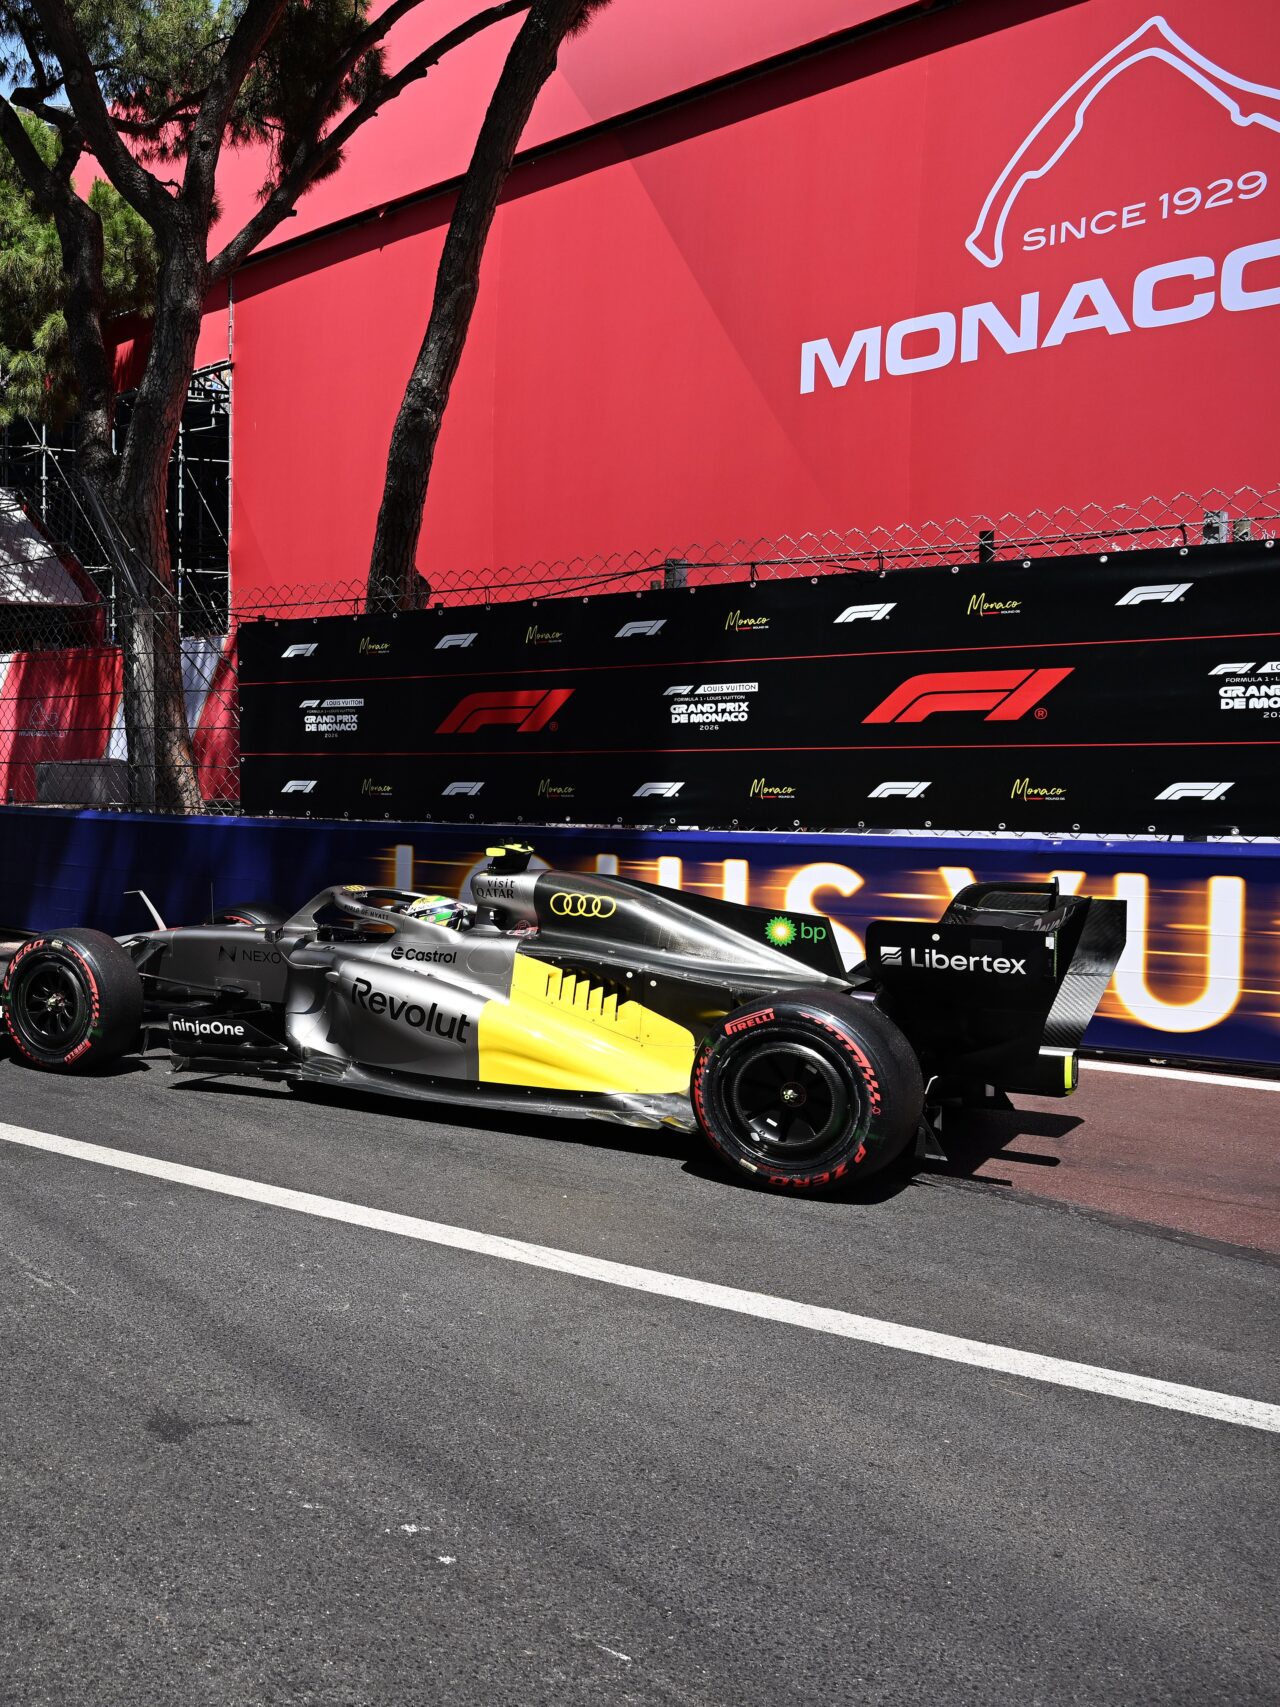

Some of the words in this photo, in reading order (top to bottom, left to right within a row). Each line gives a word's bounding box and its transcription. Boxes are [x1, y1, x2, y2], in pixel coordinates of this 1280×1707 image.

[1022, 202, 1146, 250] SINCE
[1157, 170, 1268, 220] 1929
[799, 238, 1280, 395] MONACO
[966, 592, 1022, 616] Monaco
[724, 610, 770, 631] Monaco
[525, 625, 563, 645] Monaco
[861, 667, 1075, 723] F1
[1220, 698, 1247, 710] DE
[434, 688, 575, 734] F1
[670, 703, 716, 713] GRAND
[717, 702, 750, 712] PRIX
[671, 714, 689, 723] DE
[689, 712, 749, 723] MONACO
[304, 715, 336, 723] GRAND
[336, 714, 359, 723] PRIX
[318, 723, 358, 731] MONACO
[537, 778, 575, 798] Monaco
[750, 777, 796, 800] Monaco
[1010, 777, 1067, 802] Monaco
[476, 887, 515, 900] QATAR
[487, 878, 516, 889] visit
[800, 922, 827, 944] bp
[242, 949, 282, 964] NEXO
[405, 948, 458, 964] Castrol
[910, 947, 1027, 975] Libertex
[351, 977, 471, 1044] Revolut
[172, 1018, 245, 1036] ninjaOne
[724, 1007, 776, 1036] PIRELLI
